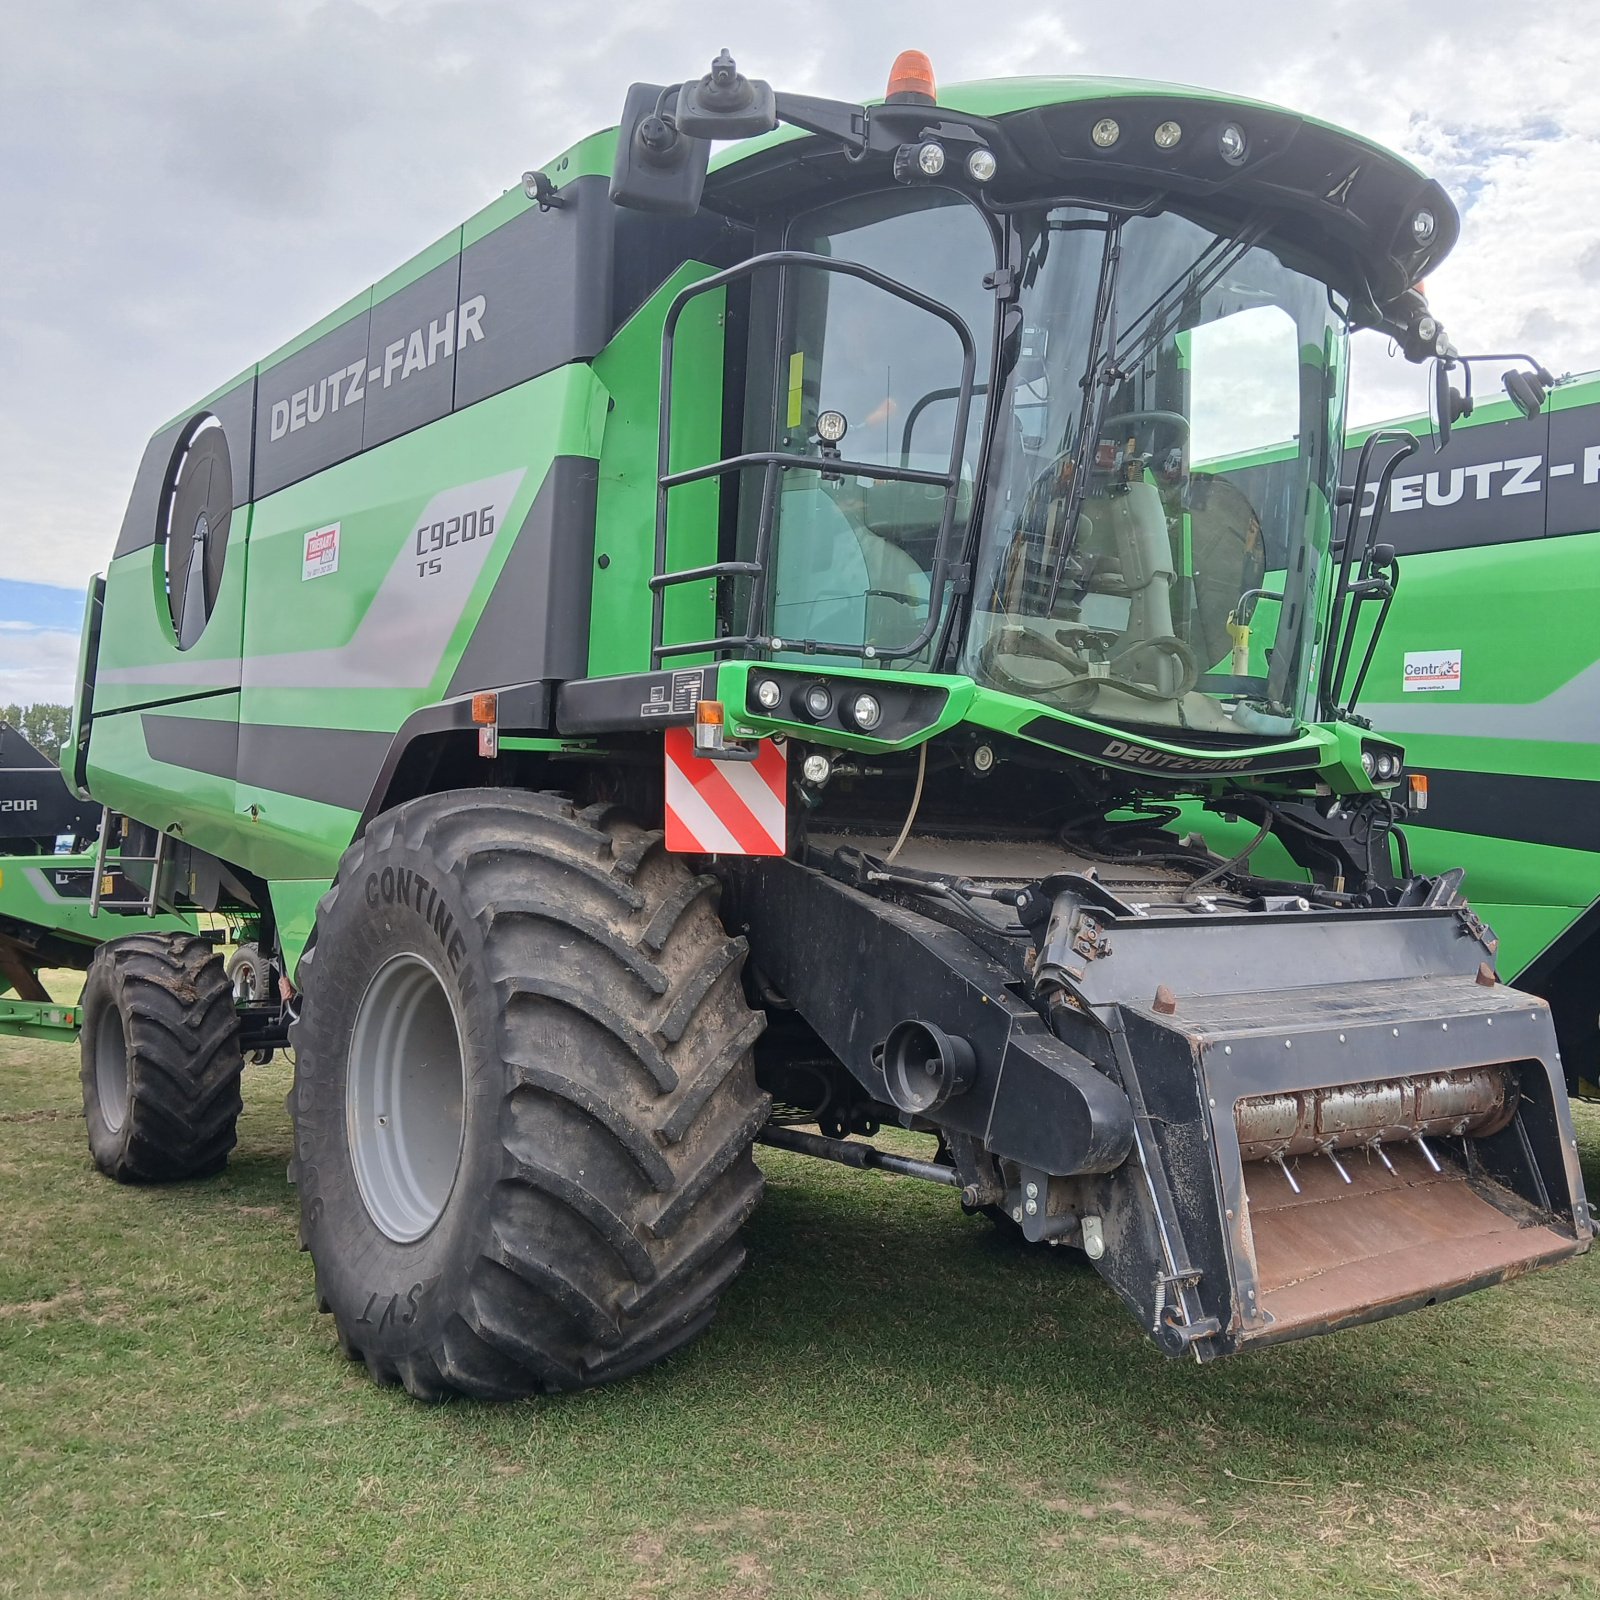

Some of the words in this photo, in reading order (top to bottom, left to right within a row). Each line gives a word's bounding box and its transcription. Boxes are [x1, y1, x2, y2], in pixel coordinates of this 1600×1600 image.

[270, 295, 486, 442] DEUTZ-FAHR
[416, 504, 494, 556] C9206
[416, 557, 442, 578] TS
[1102, 740, 1253, 770] DEUTZ-FAHR
[0, 799, 38, 812] 20A
